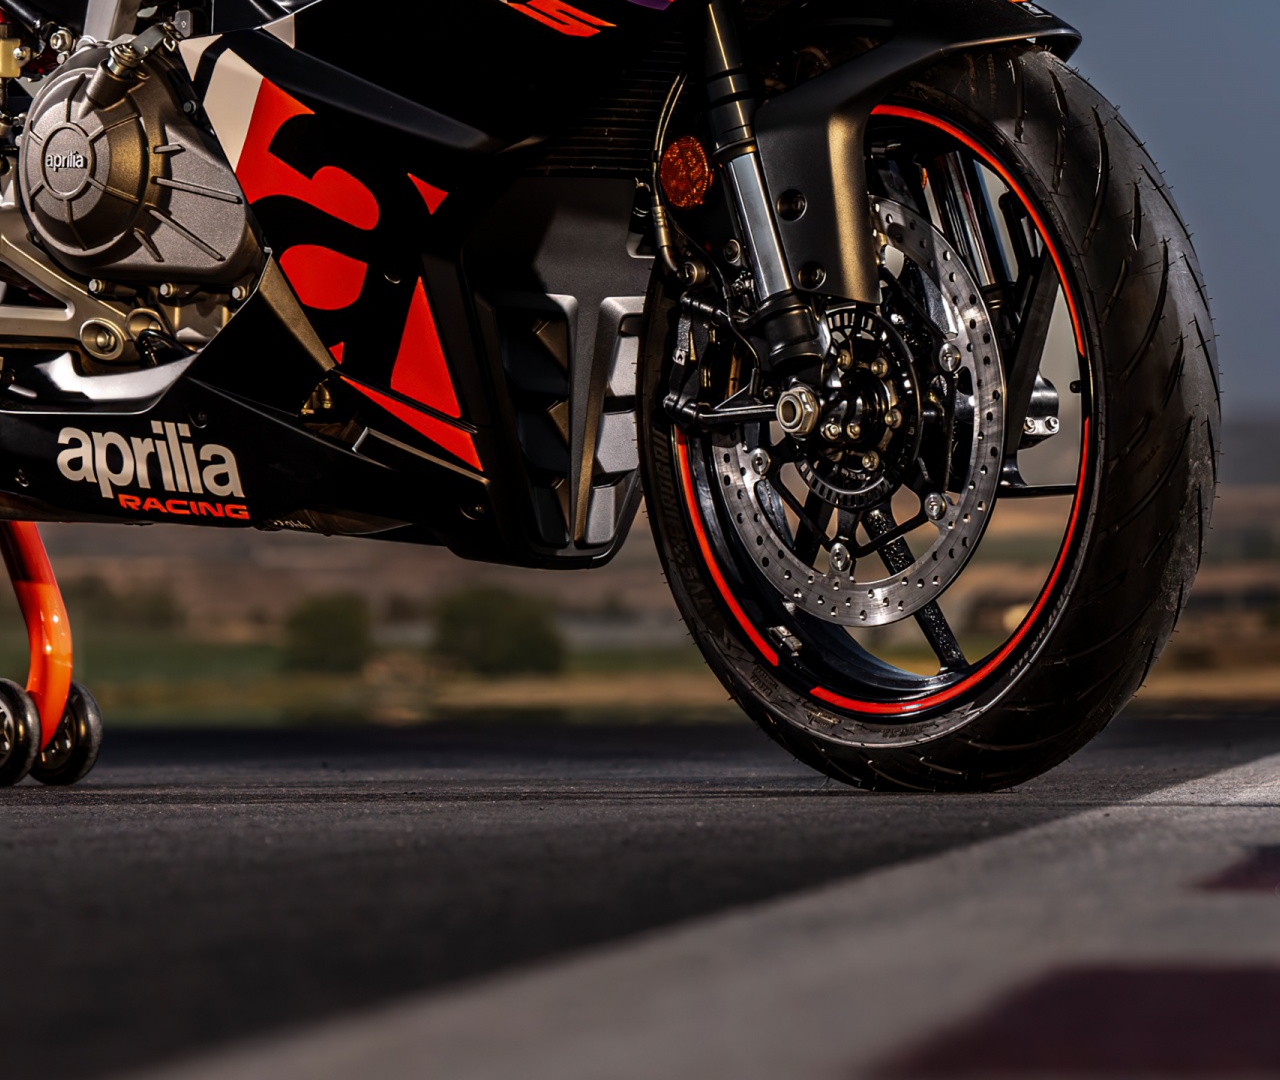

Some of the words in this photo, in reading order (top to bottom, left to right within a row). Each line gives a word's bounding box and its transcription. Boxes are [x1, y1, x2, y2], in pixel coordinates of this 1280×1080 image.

[46, 151, 84, 172] aprilia
[57, 420, 245, 499] aprilia
[118, 493, 250, 519] RACING
